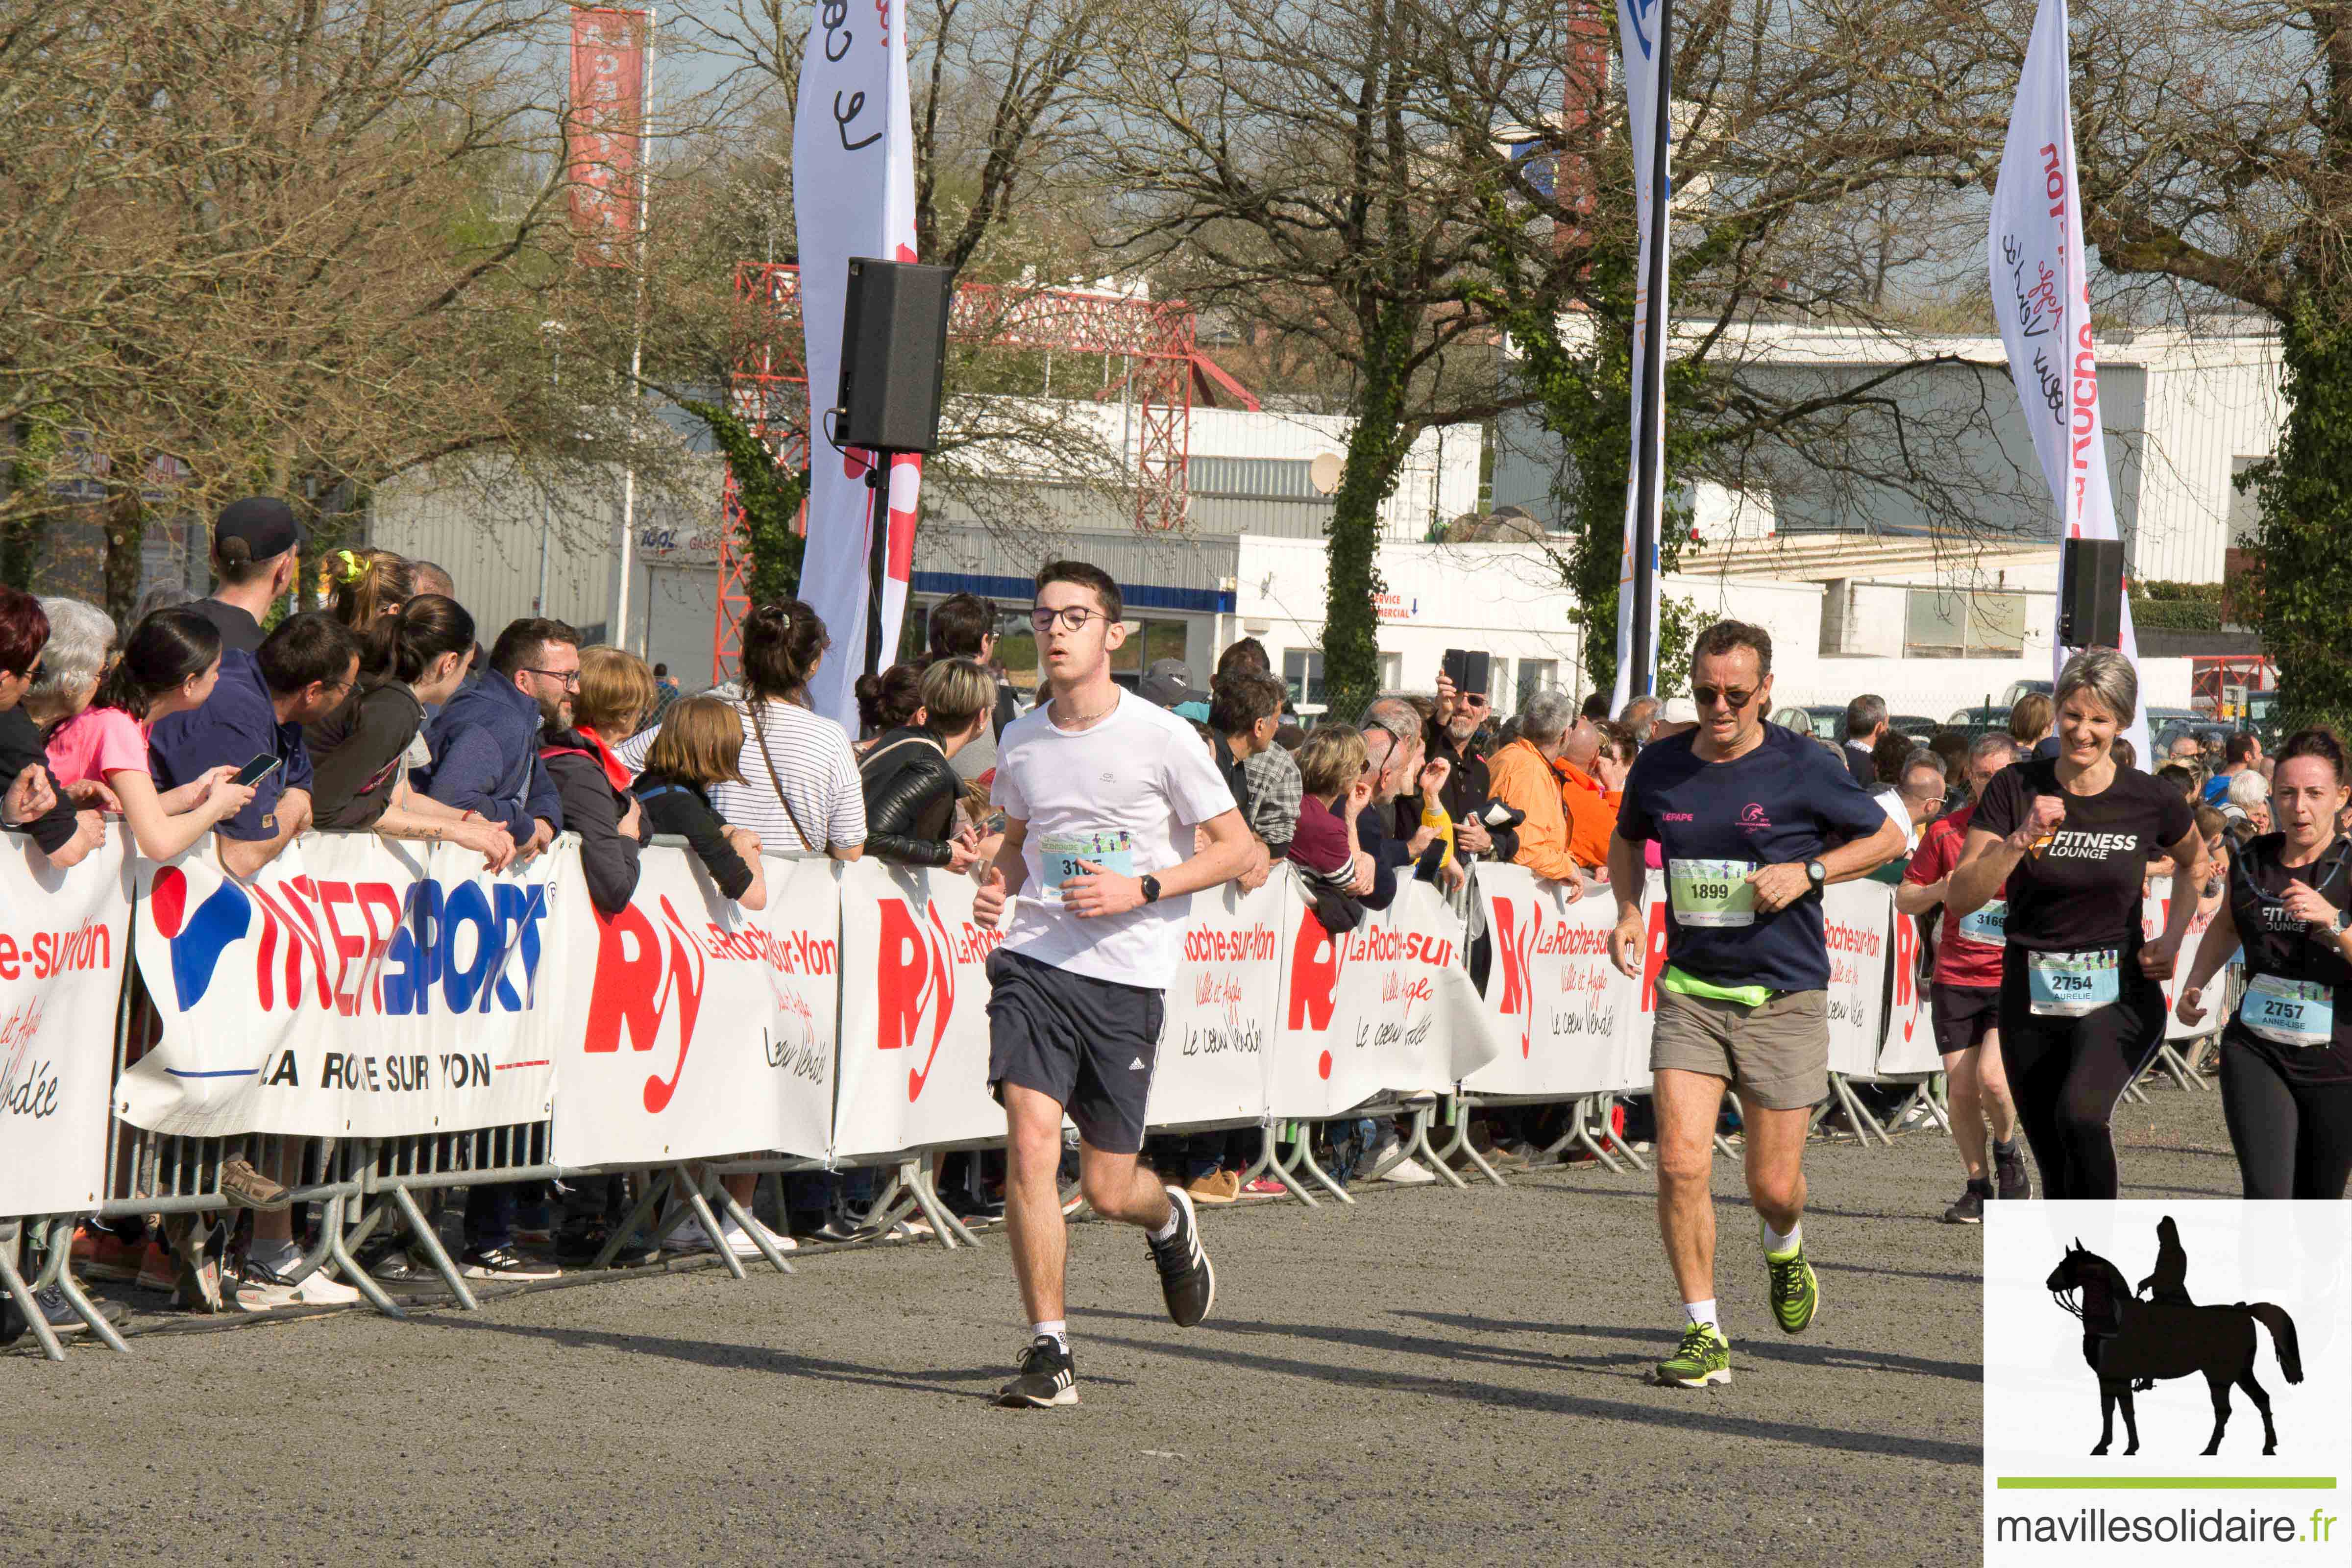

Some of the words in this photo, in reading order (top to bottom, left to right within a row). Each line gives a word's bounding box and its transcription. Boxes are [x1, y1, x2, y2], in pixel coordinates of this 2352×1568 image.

[1373, 593, 1400, 604] ERVICE
[1378, 608, 1410, 618] MERCIAL
[1662, 812, 1693, 821] LEPAPE
[2053, 831, 2138, 851] FITNESS
[2049, 846, 2109, 860] LOUNGE
[1690, 883, 1729, 899] 1899
[2052, 976, 2093, 991] 2754
[2264, 1000, 2305, 1019] 2757
[2261, 1016, 2305, 1030] ANNE-LISE
[386, 1054, 429, 1092] SUR
[439, 1053, 491, 1090] YON
